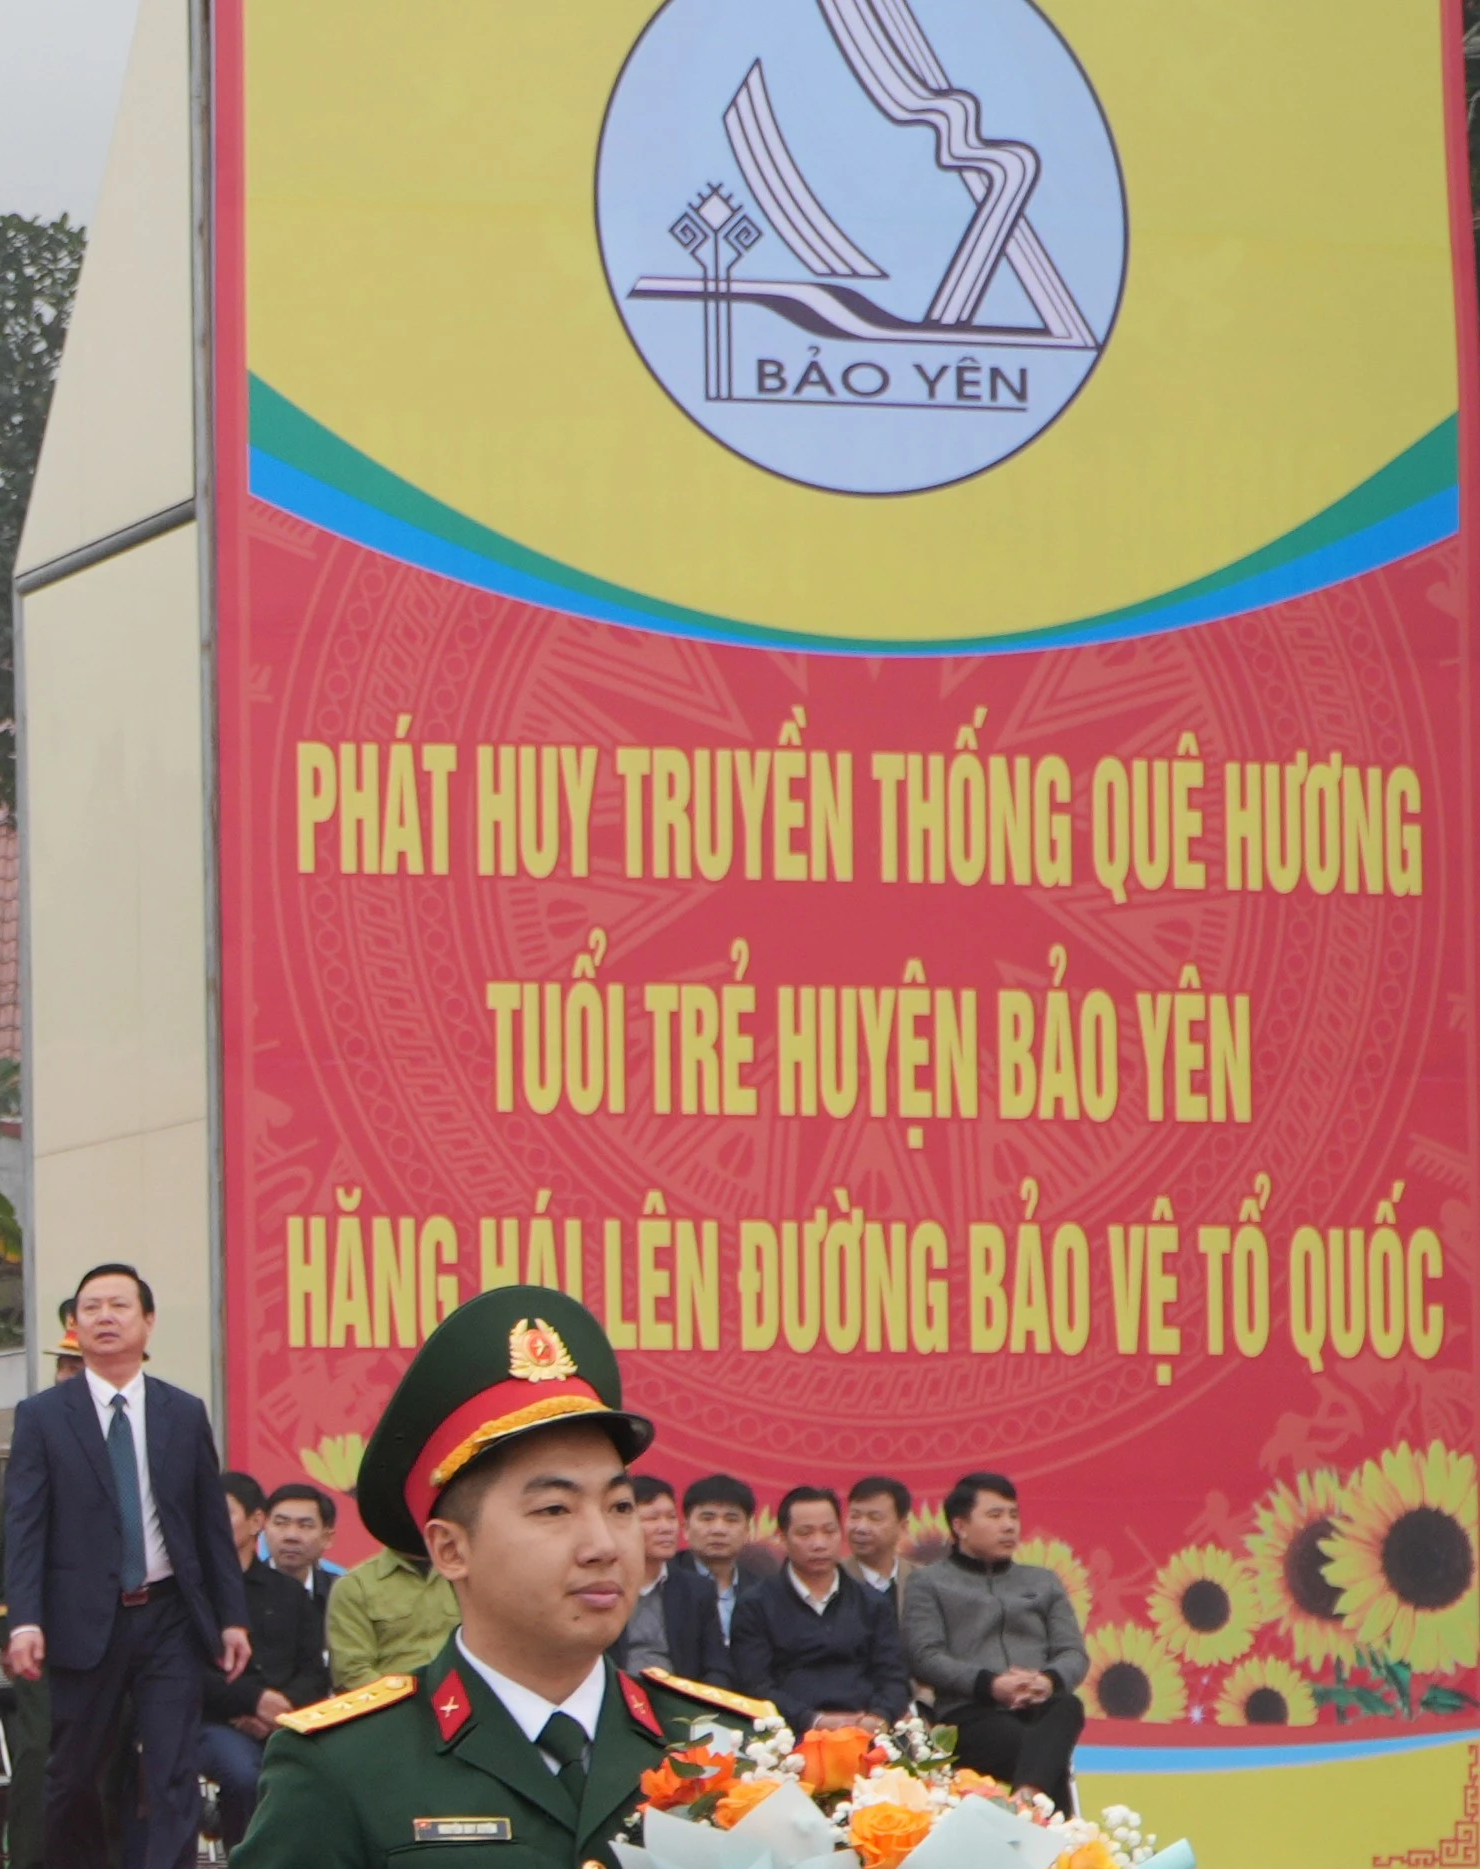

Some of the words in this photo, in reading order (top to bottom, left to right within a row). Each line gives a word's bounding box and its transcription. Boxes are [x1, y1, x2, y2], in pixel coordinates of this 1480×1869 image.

[755, 346, 891, 398] BẢO
[912, 354, 1029, 402] YÊN
[298, 715, 457, 874] PHÁT
[478, 746, 598, 877] HUY
[617, 707, 853, 881] TRUYỀN
[873, 707, 1072, 886] THỐNG
[1093, 732, 1206, 902] QUÊ
[1226, 751, 1423, 895] HƯƠNG
[487, 930, 625, 1113] TUỔI
[645, 939, 757, 1114] TRẺ
[778, 960, 978, 1147] HUYỆN
[999, 945, 1118, 1121] BẢO
[1137, 965, 1251, 1122] YÊN
[288, 1189, 460, 1347] HĂNG
[480, 1190, 583, 1304] HÁI
[603, 1191, 720, 1350] LÊN
[739, 1189, 949, 1353] ĐƯỜNG
[970, 1179, 1090, 1354] BẢO
[1108, 1198, 1181, 1384] VỆ
[1199, 1174, 1271, 1356] TỔ
[1290, 1182, 1444, 1371] QUỐC
